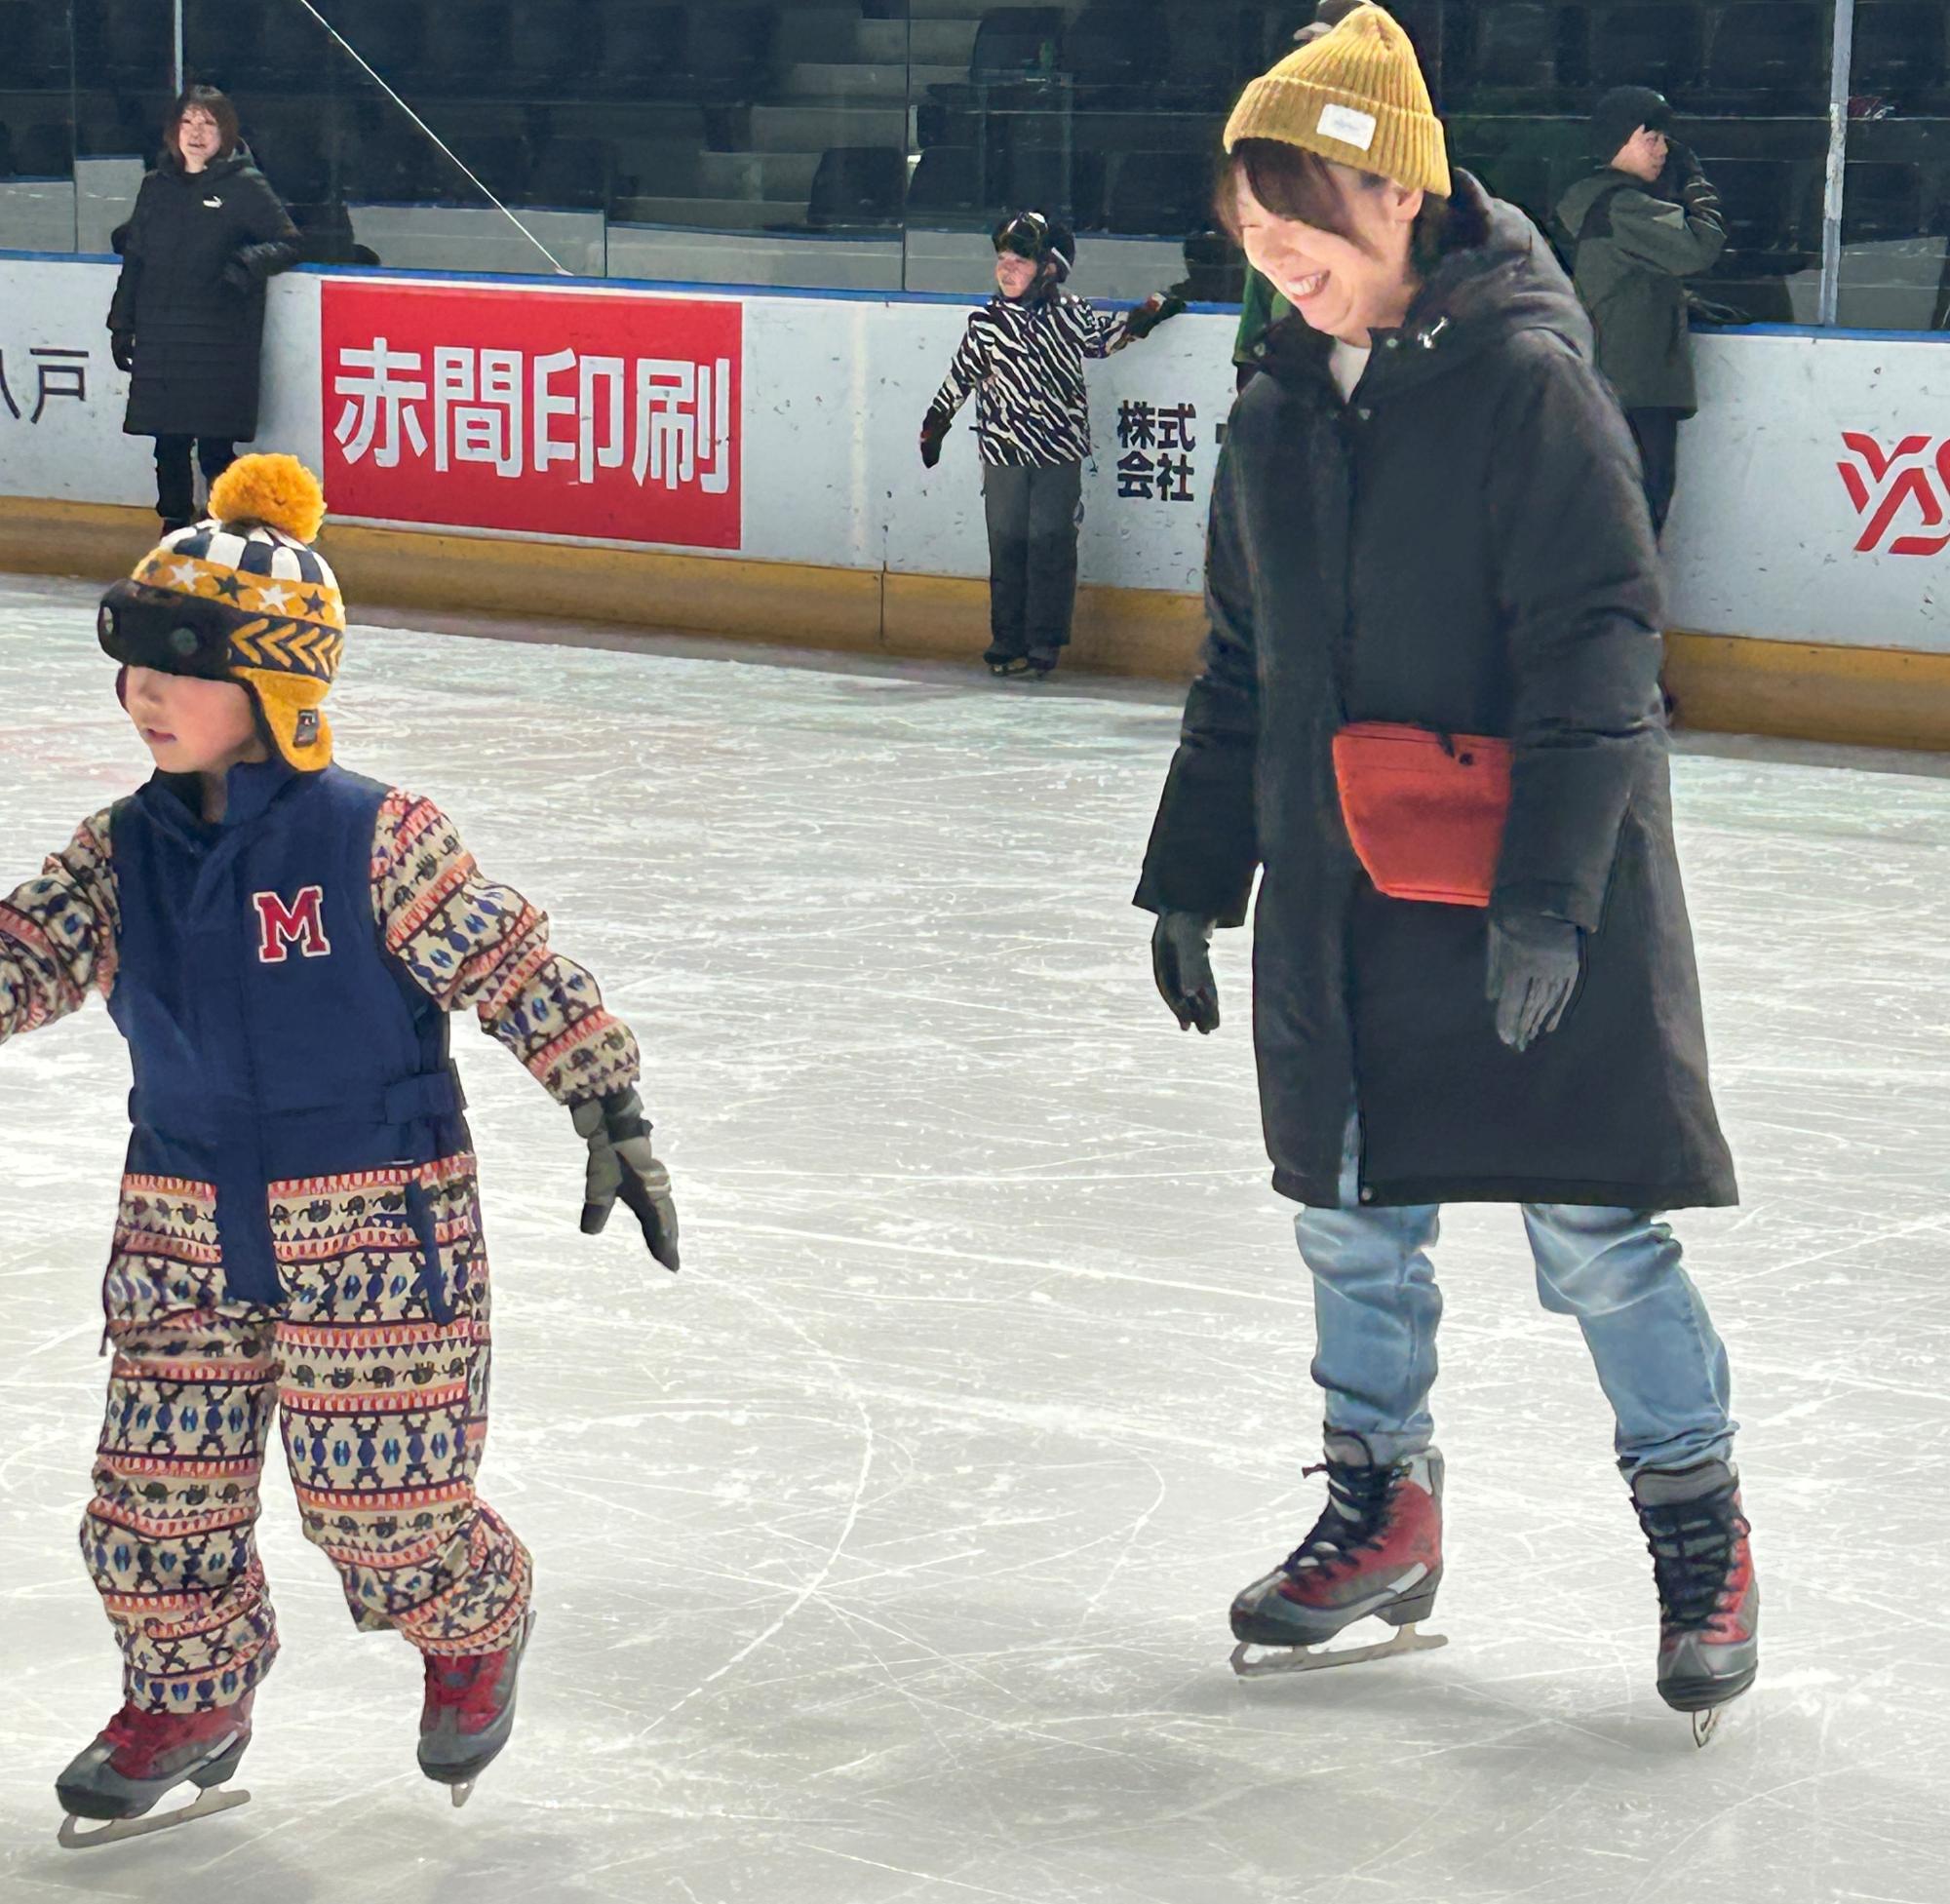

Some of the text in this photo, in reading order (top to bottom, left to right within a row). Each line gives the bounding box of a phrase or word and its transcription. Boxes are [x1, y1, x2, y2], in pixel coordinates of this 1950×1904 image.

[333, 336, 730, 494] 赤間印刷
[1116, 400, 1196, 451] 株式
[1116, 450, 1195, 502] 会社
[253, 884, 331, 963] M
